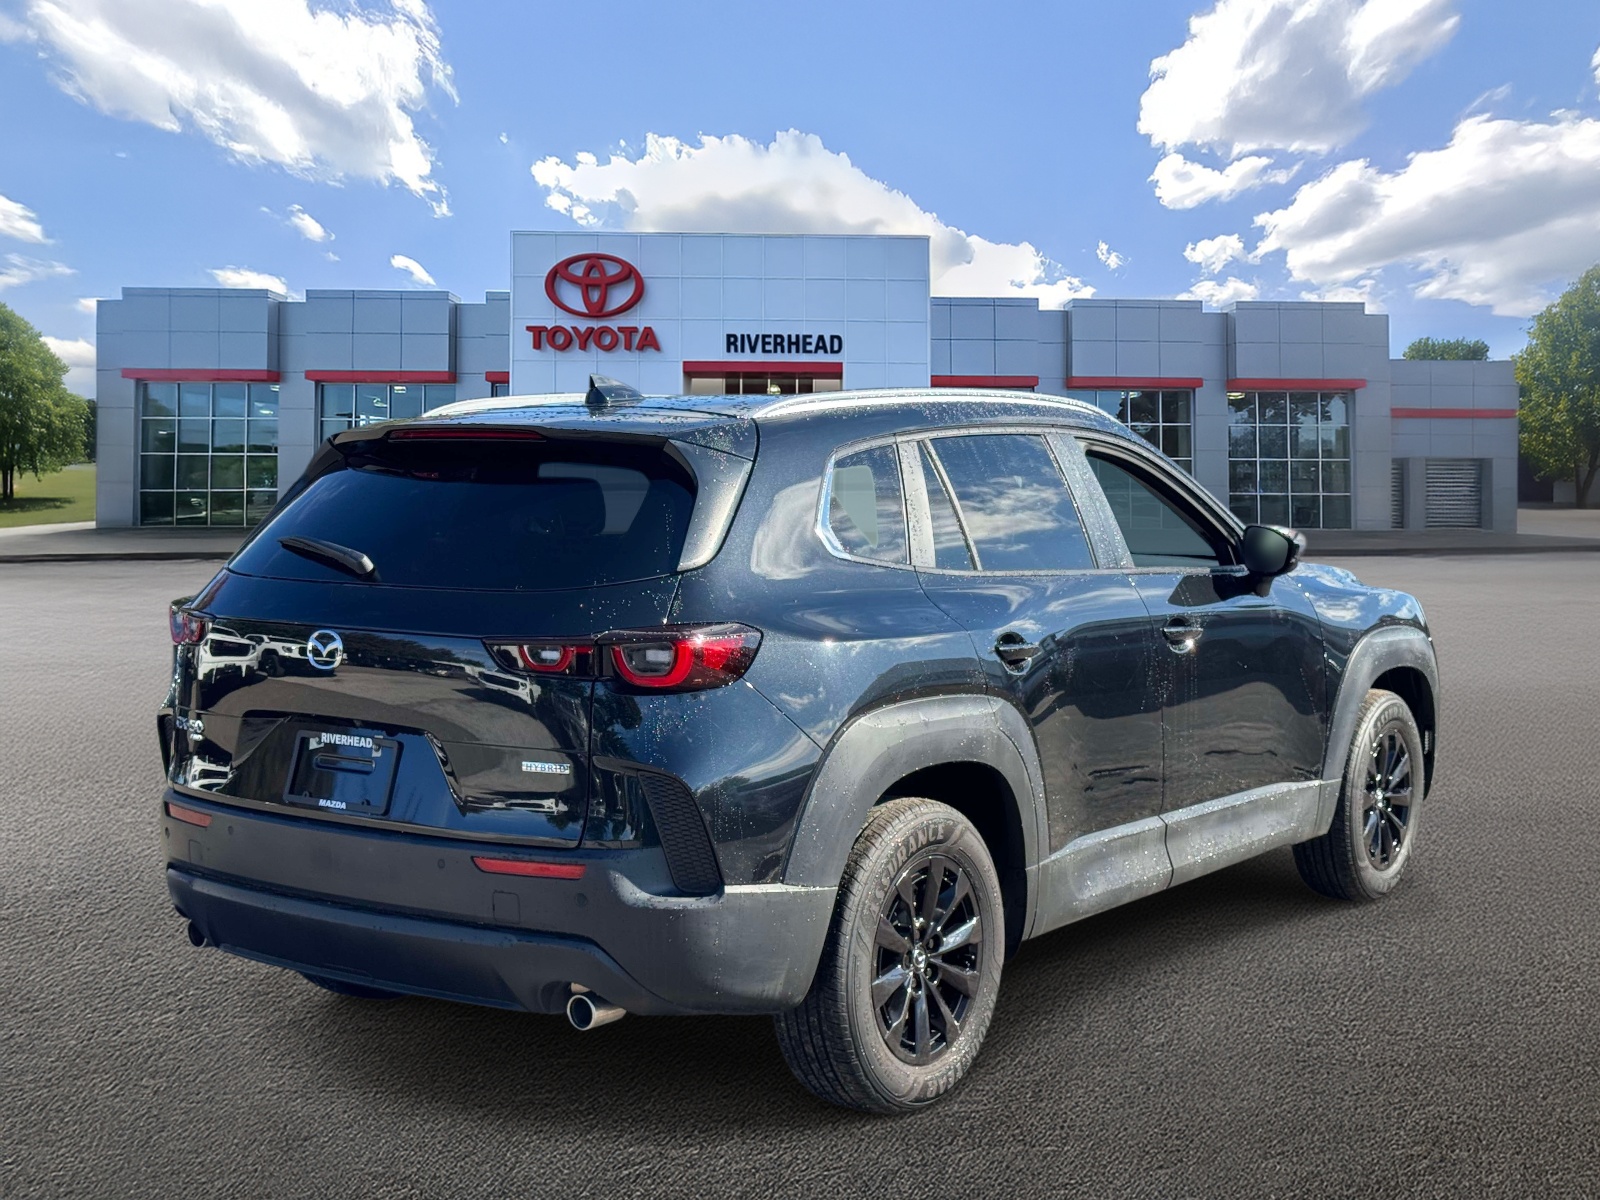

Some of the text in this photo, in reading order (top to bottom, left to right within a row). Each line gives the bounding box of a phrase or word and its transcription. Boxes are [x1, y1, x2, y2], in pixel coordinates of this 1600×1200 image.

[526, 326, 661, 351] TOYOTA
[725, 334, 843, 354] RIVERHEAD
[321, 732, 373, 748] RIVERHEAD
[525, 763, 567, 773] HYBRID
[318, 799, 347, 809] MAZDA
